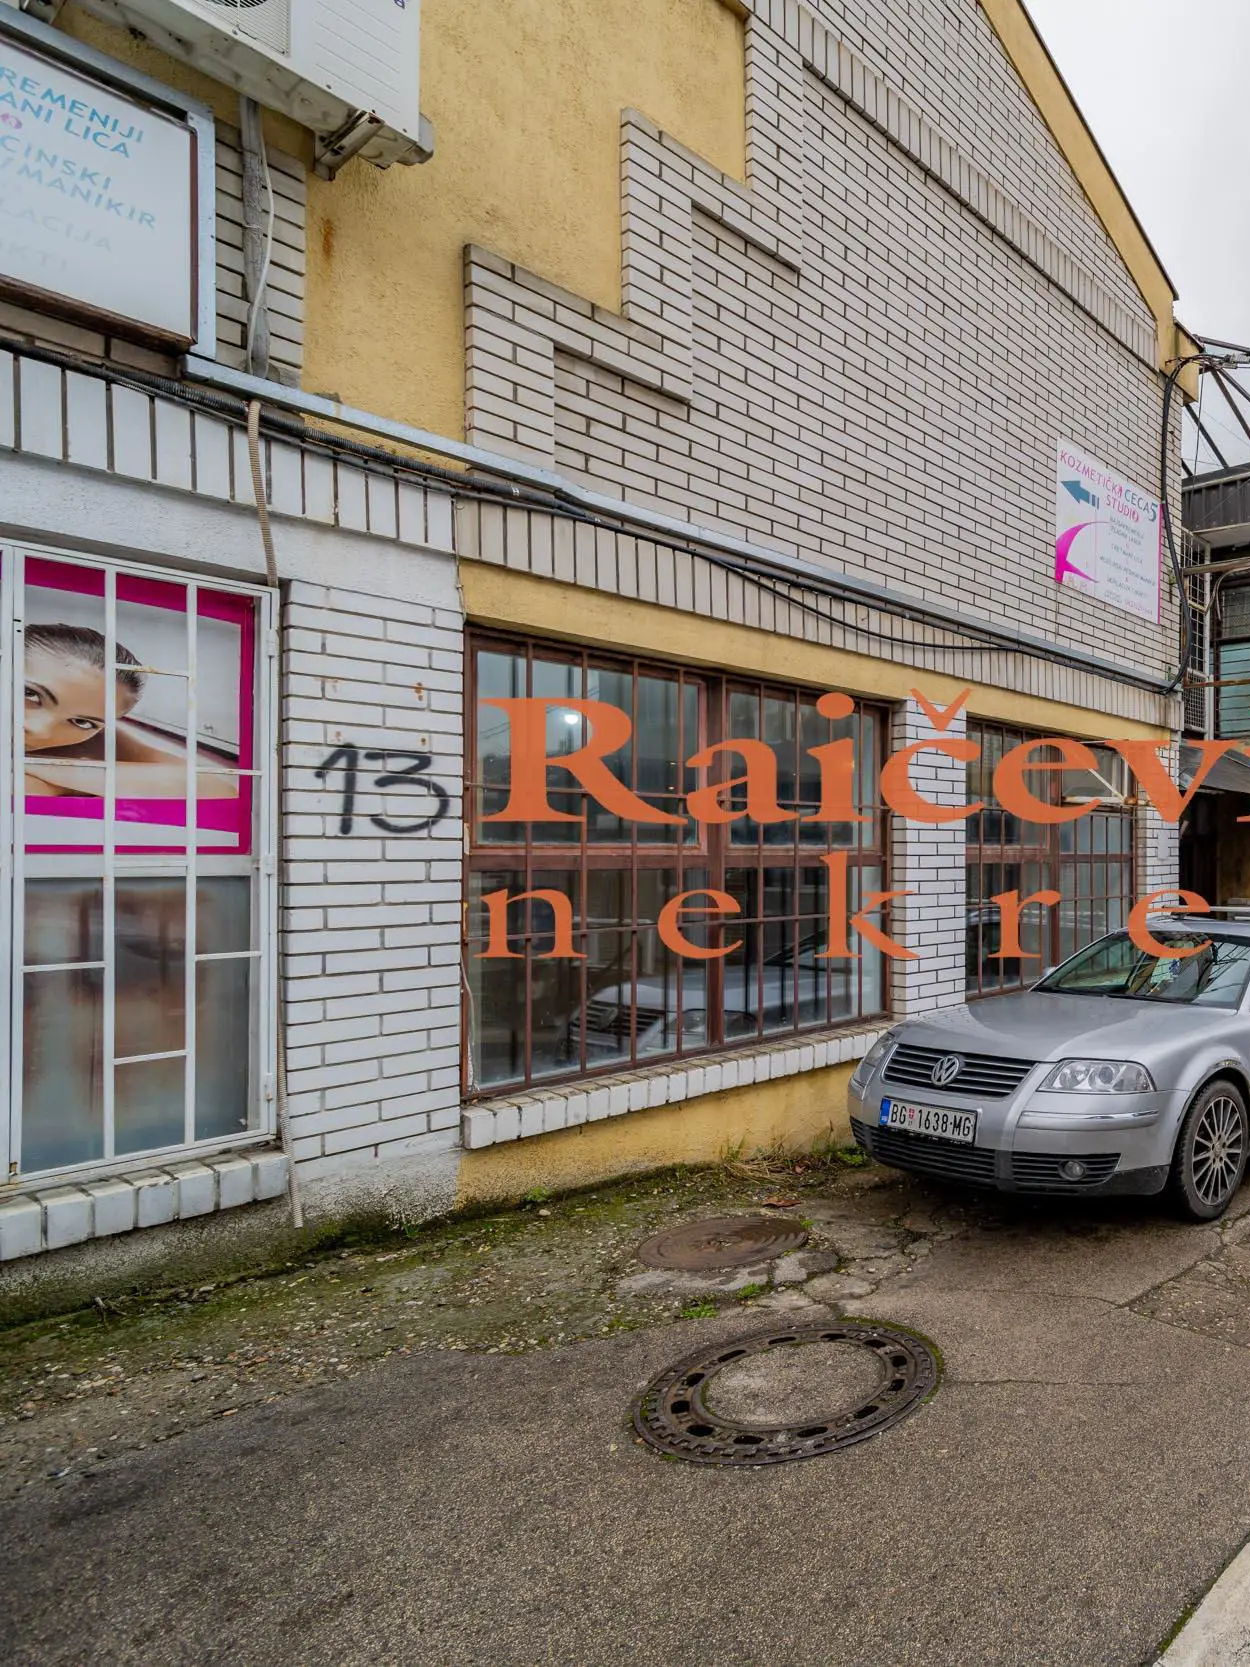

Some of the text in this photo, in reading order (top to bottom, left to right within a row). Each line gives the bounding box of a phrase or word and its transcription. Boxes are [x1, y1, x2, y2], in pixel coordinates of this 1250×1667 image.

[64, 117, 130, 158] LICA
[314, 743, 449, 835] 13
[890, 1104, 907, 1124] BG
